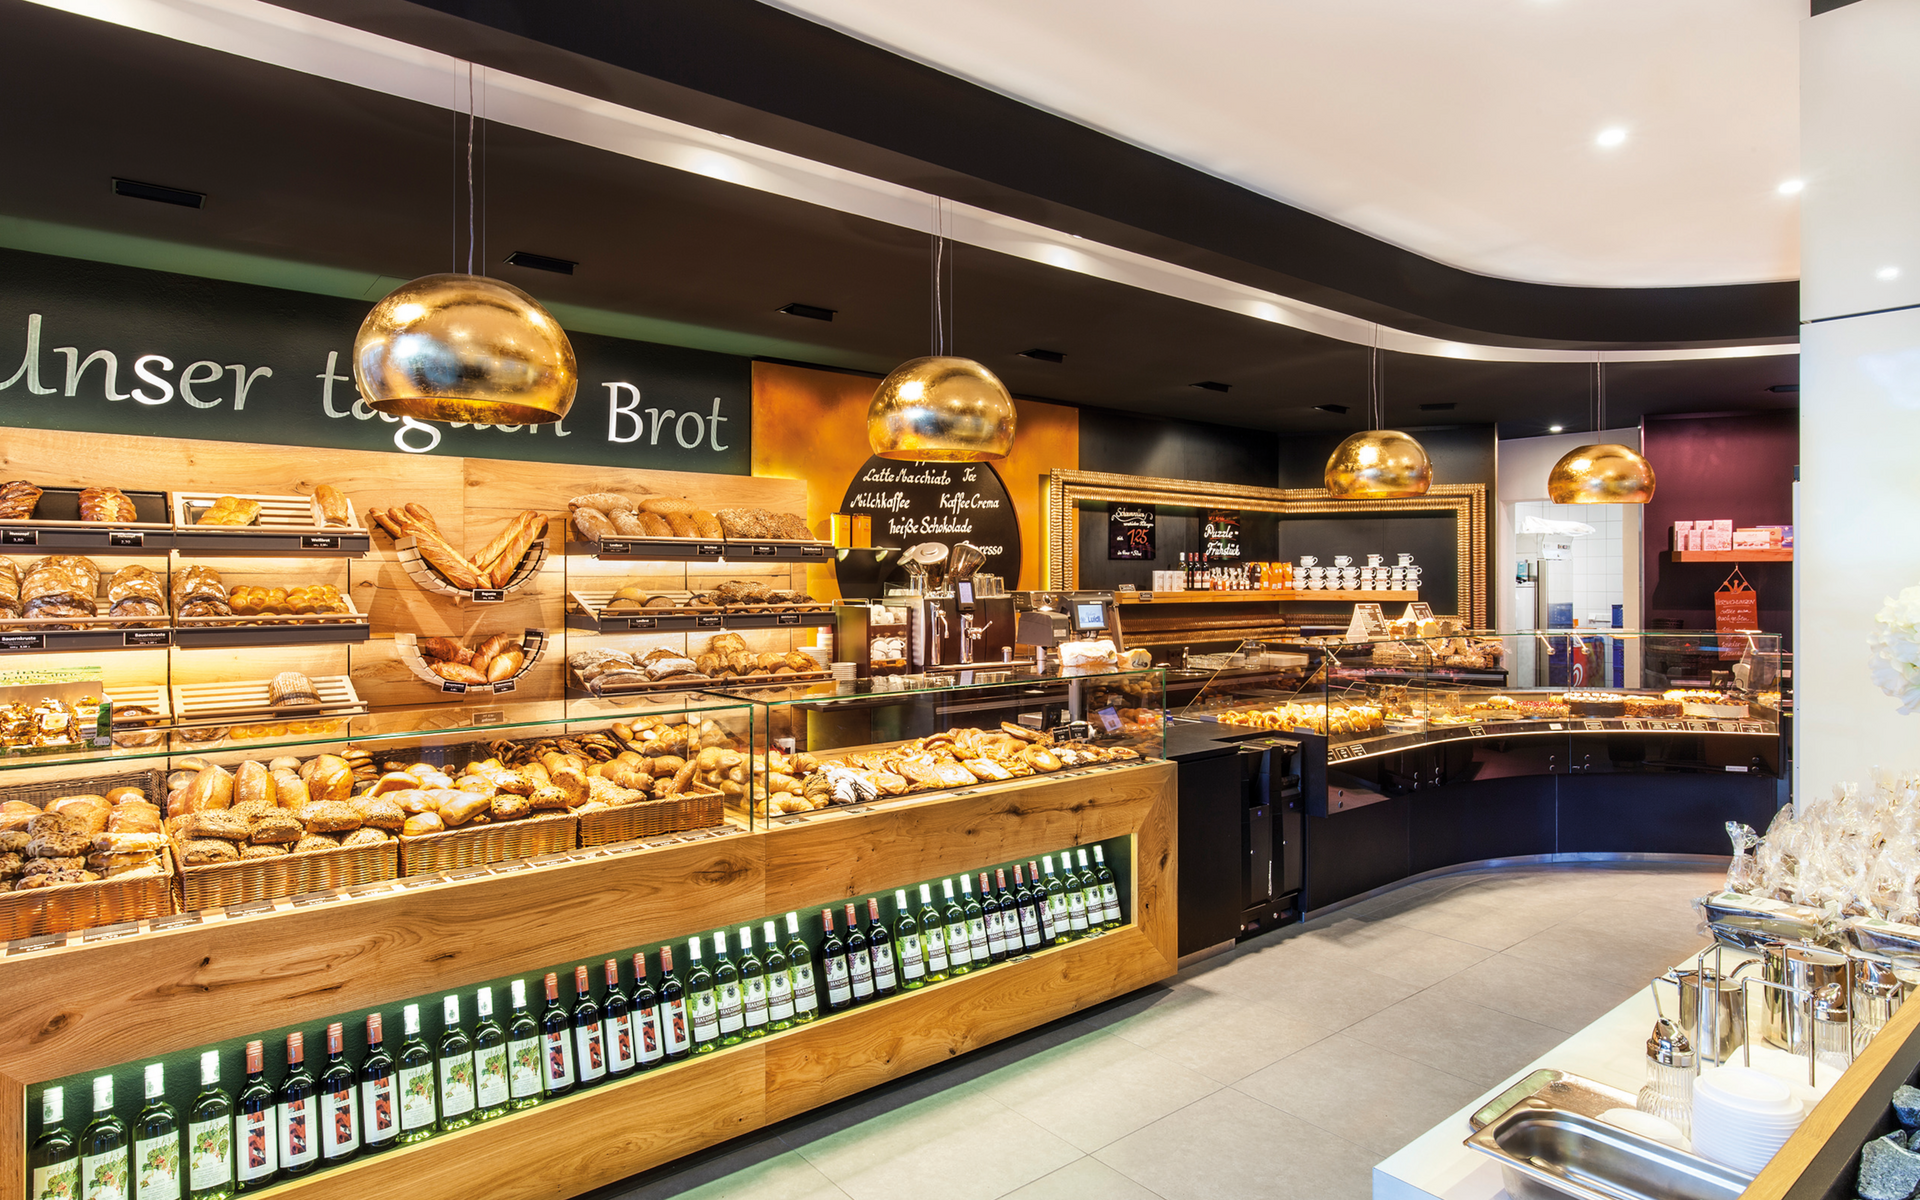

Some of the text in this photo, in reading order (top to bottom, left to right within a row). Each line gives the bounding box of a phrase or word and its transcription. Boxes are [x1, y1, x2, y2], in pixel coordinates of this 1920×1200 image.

[0, 313, 273, 411] Unser
[602, 382, 728, 452] Brot
[862, 466, 977, 485] Latte Macchiato Tee
[850, 491, 1000, 515] Milchkaffee Kaffee Crema
[888, 515, 973, 540] heiße Schokolade
